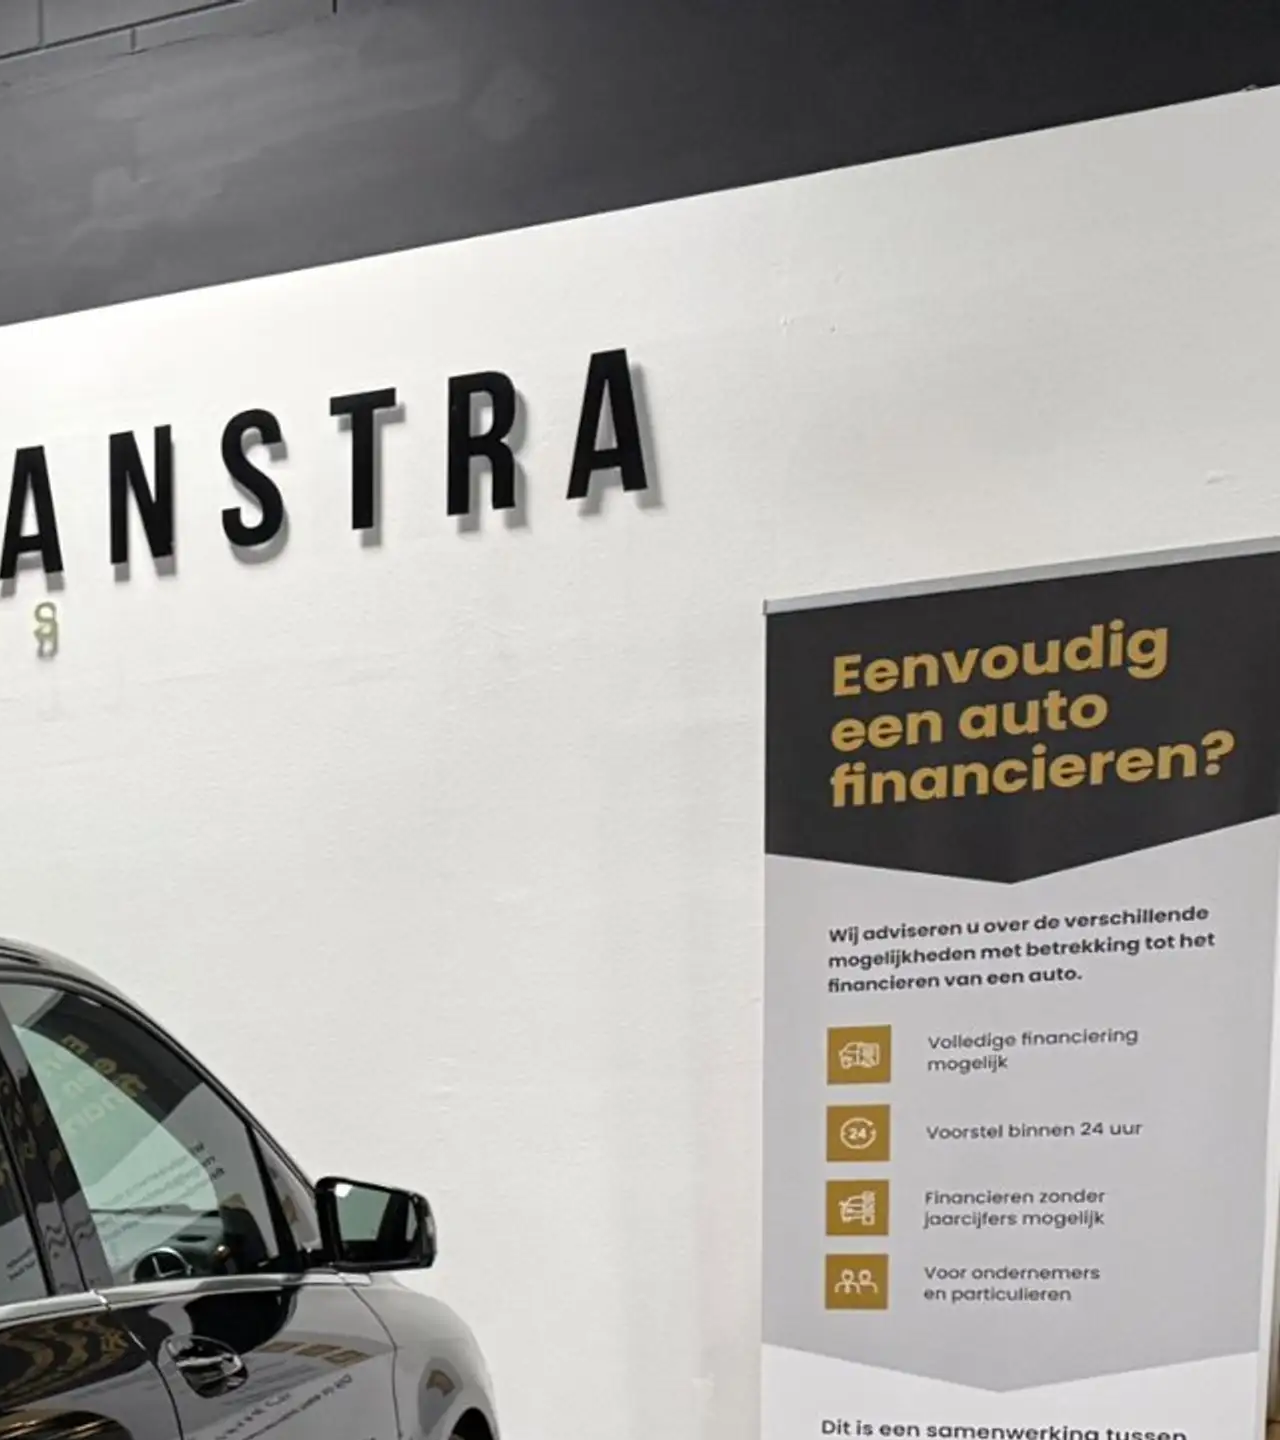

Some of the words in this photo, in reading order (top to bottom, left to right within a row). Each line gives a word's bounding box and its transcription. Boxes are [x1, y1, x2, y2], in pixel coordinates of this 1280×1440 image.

[832, 618, 1169, 697] Eenvoudig
[830, 708, 943, 753] een
[958, 690, 1109, 740] auto
[830, 729, 1236, 808] financieren?
[829, 926, 859, 946] Wij
[863, 923, 962, 941] adviseren
[967, 921, 979, 934] u
[984, 919, 1029, 933] over
[1034, 915, 1060, 930] de
[1064, 906, 1210, 929] verschillende
[828, 947, 975, 971] mogelijkheden
[981, 944, 1022, 959] met
[1026, 937, 1140, 957] betrekking
[1145, 933, 1175, 950] tot
[1180, 932, 1215, 948] het
[828, 975, 940, 993] financieren
[944, 973, 982, 987] van
[987, 971, 1024, 986] een
[1029, 966, 1083, 983] auto.
[928, 1032, 1016, 1051] Volledige
[1021, 1028, 1139, 1046] financiering
[927, 1055, 1008, 1075] mogelijk
[926, 1124, 1003, 1140] Voorstel
[1008, 1123, 1075, 1139] binnen
[1080, 1121, 1104, 1136] 24
[1109, 1122, 1143, 1136] uur
[924, 1190, 1034, 1205] Financieren
[1039, 1189, 1105, 1204] zonder
[923, 1211, 1017, 1229] jaarcijfers
[1022, 1210, 1105, 1228] mogelijk
[924, 1266, 967, 1280] Voor
[971, 1265, 1101, 1280] ondernemers
[924, 1288, 946, 1301] en
[951, 1286, 1072, 1304] particulieren
[821, 1418, 851, 1436] Dit
[855, 1420, 874, 1437] is
[879, 1422, 920, 1438] een
